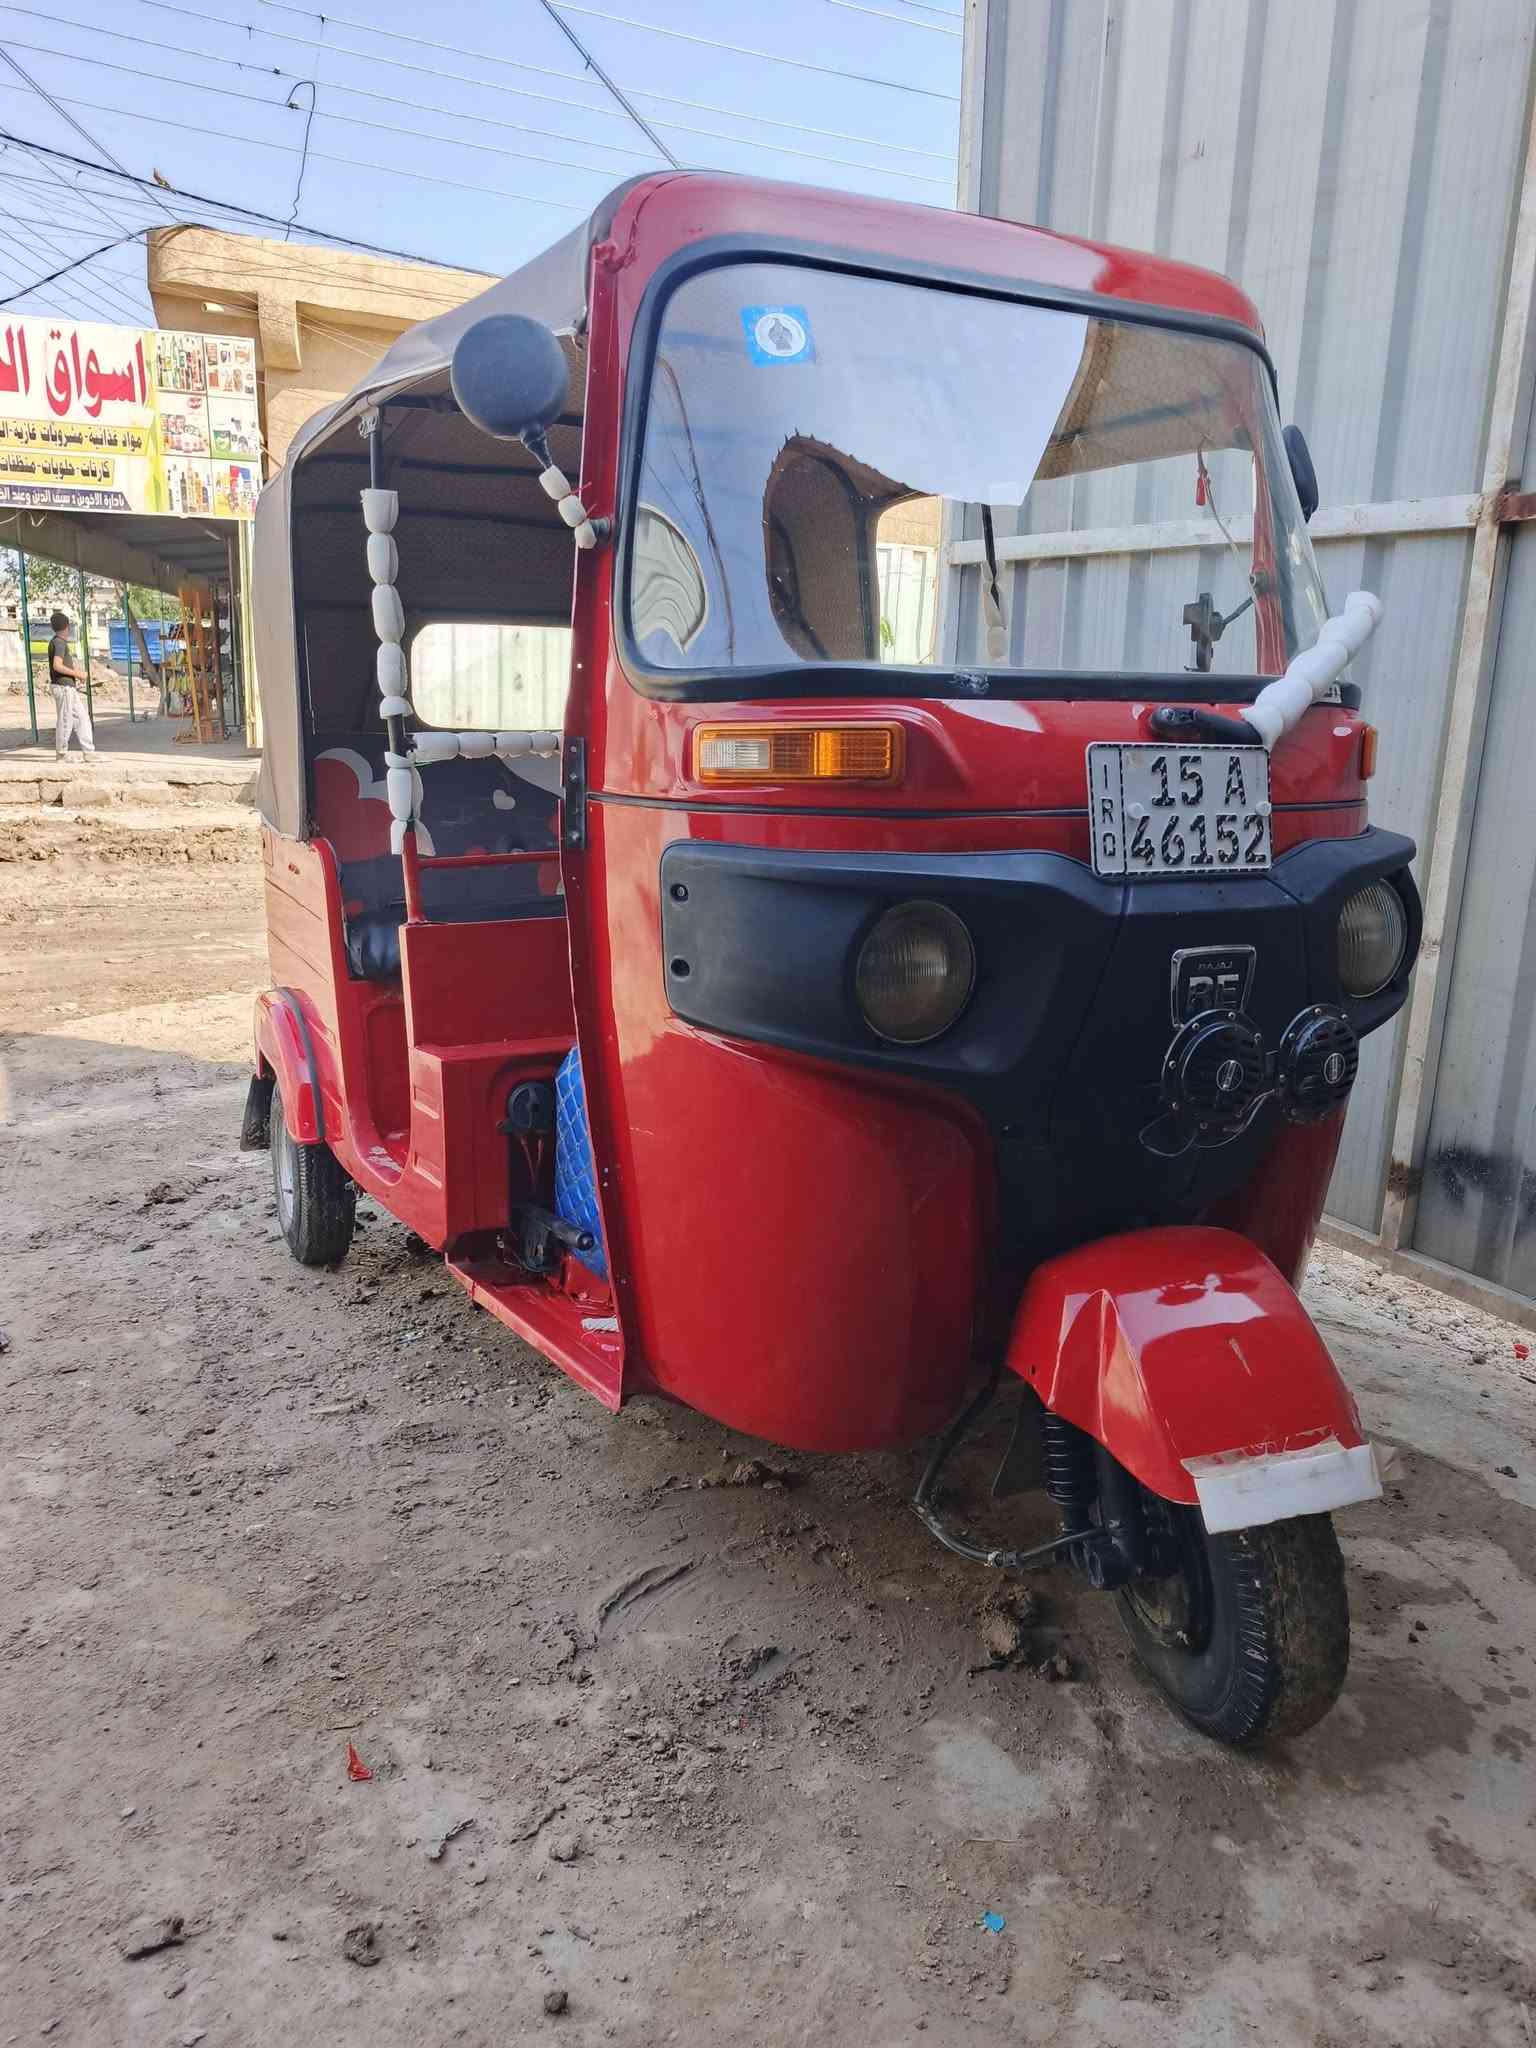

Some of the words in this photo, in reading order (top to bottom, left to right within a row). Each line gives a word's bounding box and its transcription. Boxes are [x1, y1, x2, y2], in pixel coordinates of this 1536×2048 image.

[45, 329, 147, 417] اسواق
[14, 420, 36, 444] غازية
[41, 421, 83, 447] مشروبات
[89, 427, 118, 449] غذائية
[121, 431, 142, 452] مواد
[42, 457, 75, 480] حلويات
[1151, 755, 1204, 806] 15
[1224, 756, 1246, 805] A
[1130, 814, 1267, 866] 46152
[1188, 973, 1240, 1009] RE
